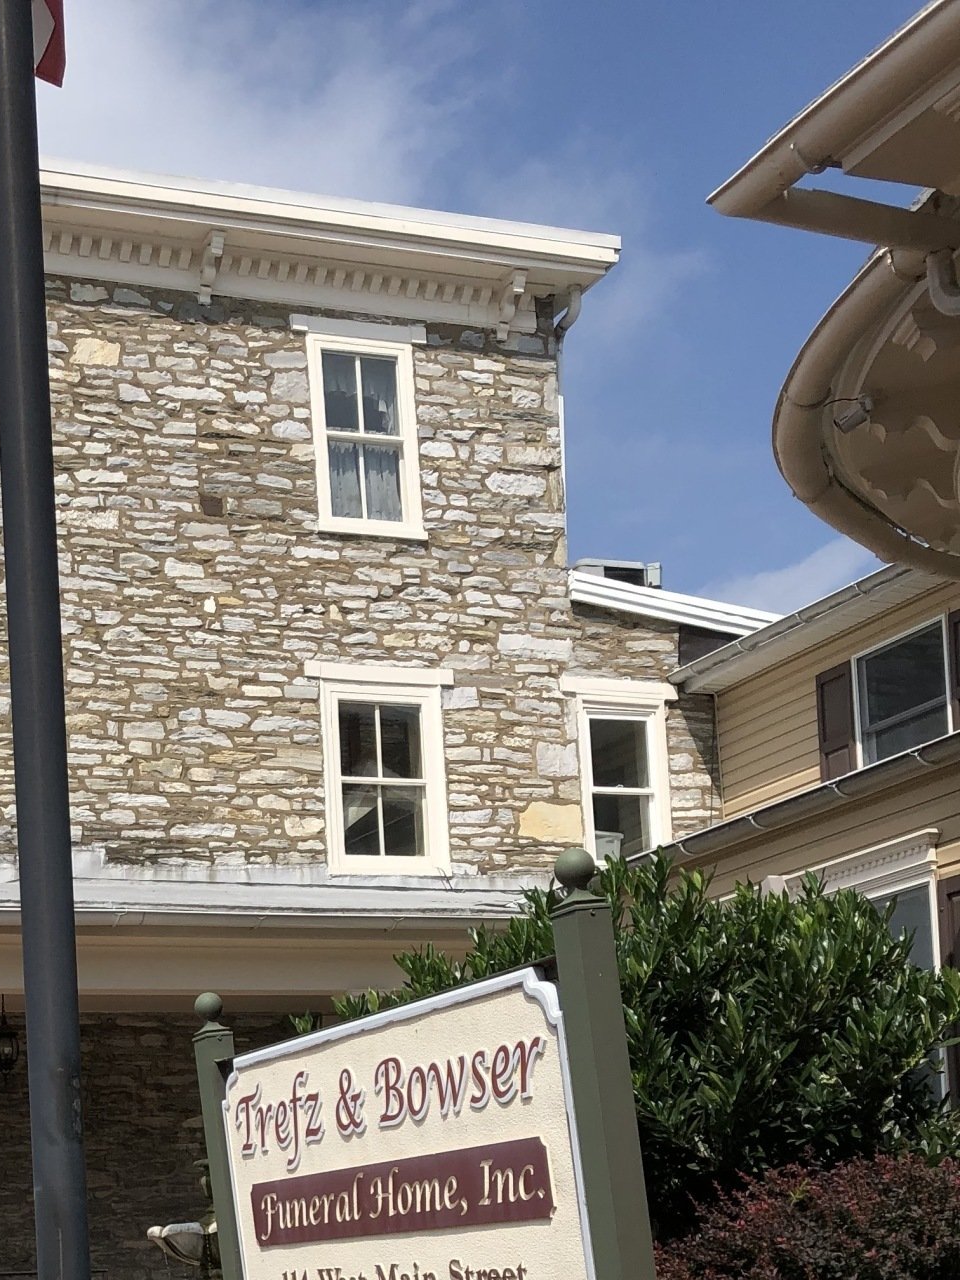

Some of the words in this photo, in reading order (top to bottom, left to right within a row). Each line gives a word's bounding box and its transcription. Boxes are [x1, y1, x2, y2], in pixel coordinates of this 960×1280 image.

[236, 1071, 324, 1172] Trefz
[335, 1068, 366, 1135] &
[374, 1036, 547, 1126] Bowser
[261, 1172, 364, 1240] Funeral
[369, 1166, 468, 1219] Home,
[478, 1158, 546, 1206] Inc.
